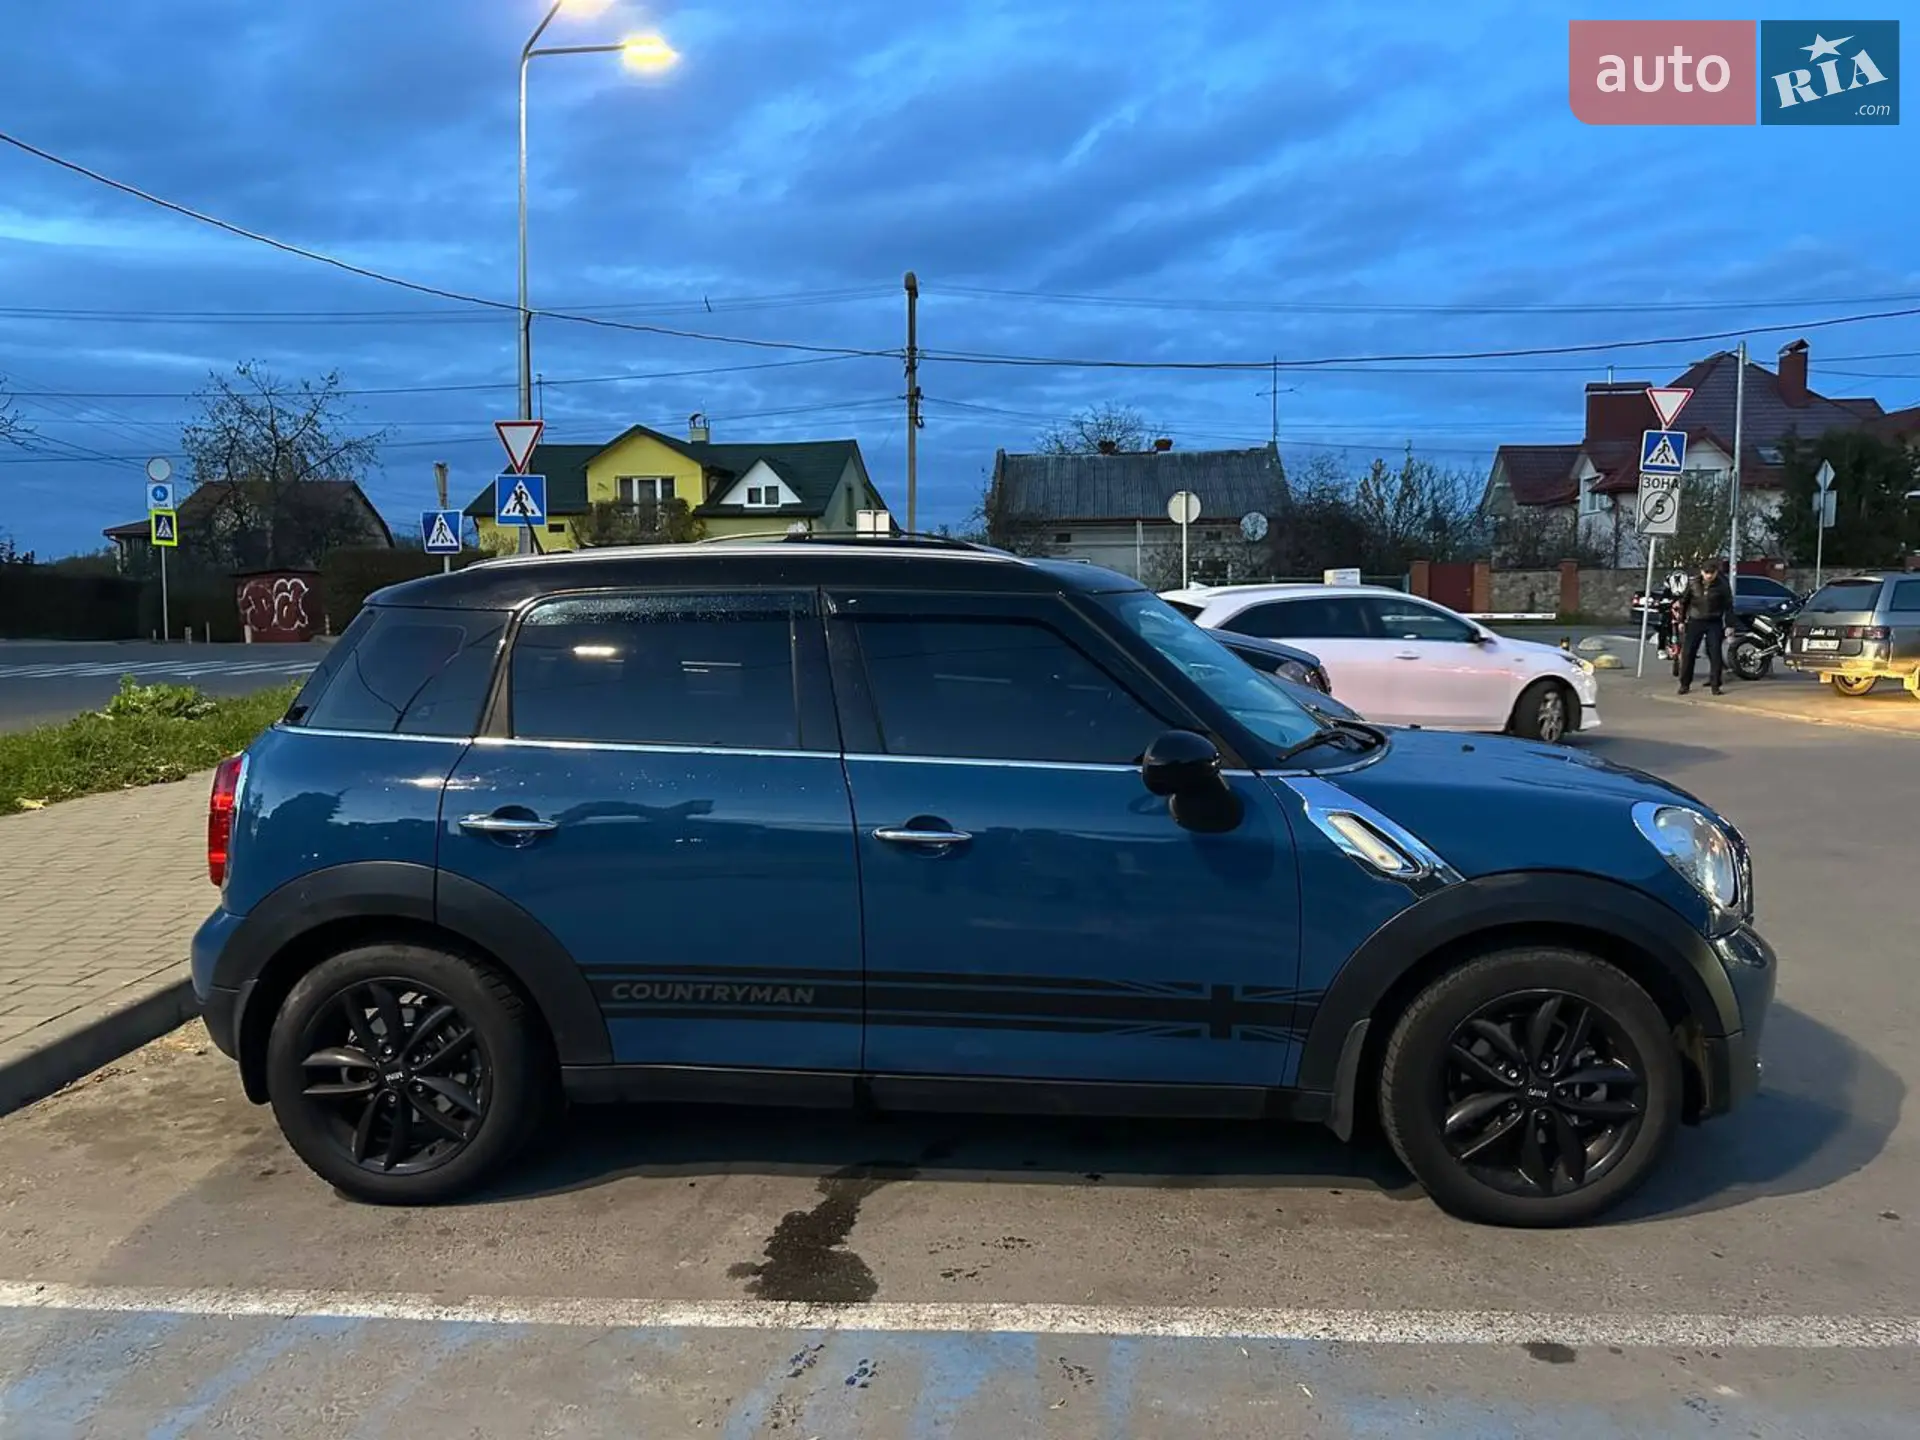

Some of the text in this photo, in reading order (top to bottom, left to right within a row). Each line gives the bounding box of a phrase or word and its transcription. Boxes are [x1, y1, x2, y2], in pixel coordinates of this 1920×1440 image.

[1643, 476, 1680, 490] ЗОНА
[1655, 499, 1665, 515] 5
[610, 983, 815, 1004] COUNTRYMAN
